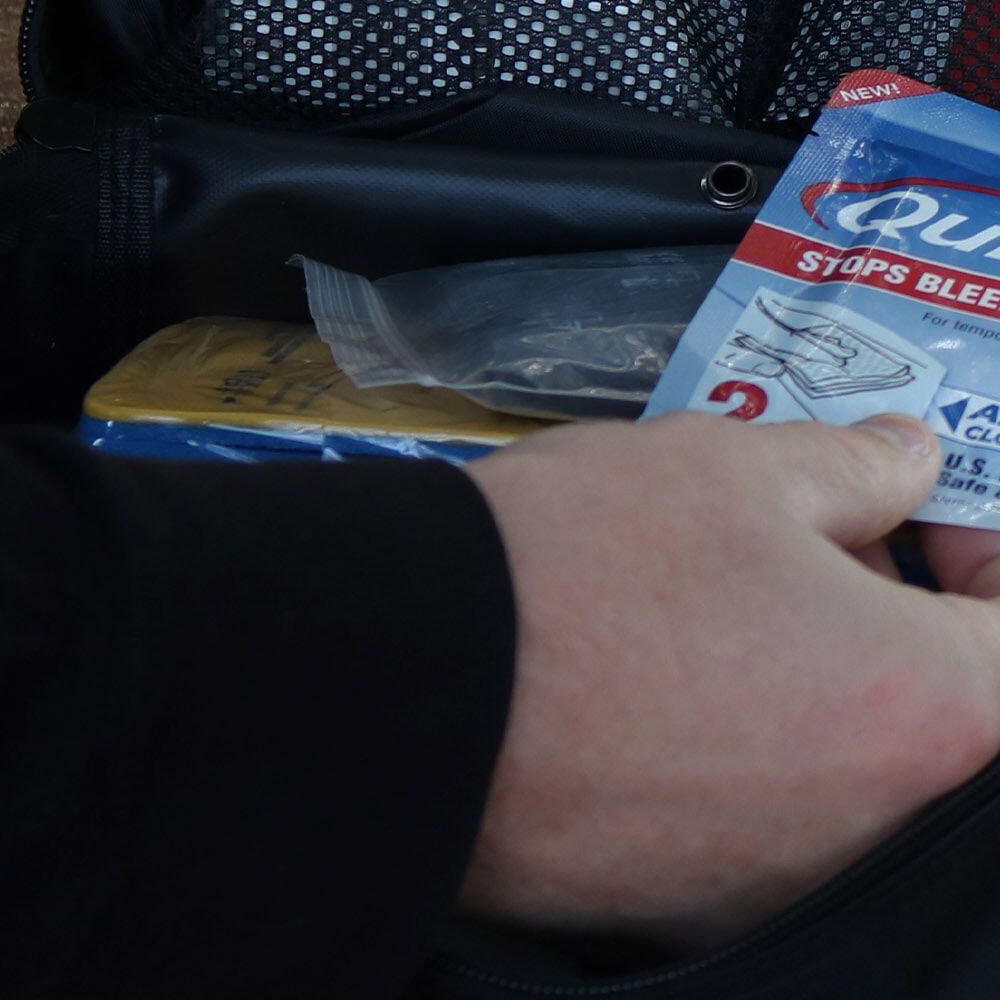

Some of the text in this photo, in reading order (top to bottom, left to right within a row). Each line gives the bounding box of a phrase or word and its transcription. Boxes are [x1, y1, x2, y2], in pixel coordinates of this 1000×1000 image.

[840, 83, 901, 102] NEW!
[797, 250, 911, 285] STOPS
[921, 311, 950, 328] For
[944, 453, 990, 479] U.S.
[936, 470, 988, 495] Safe
